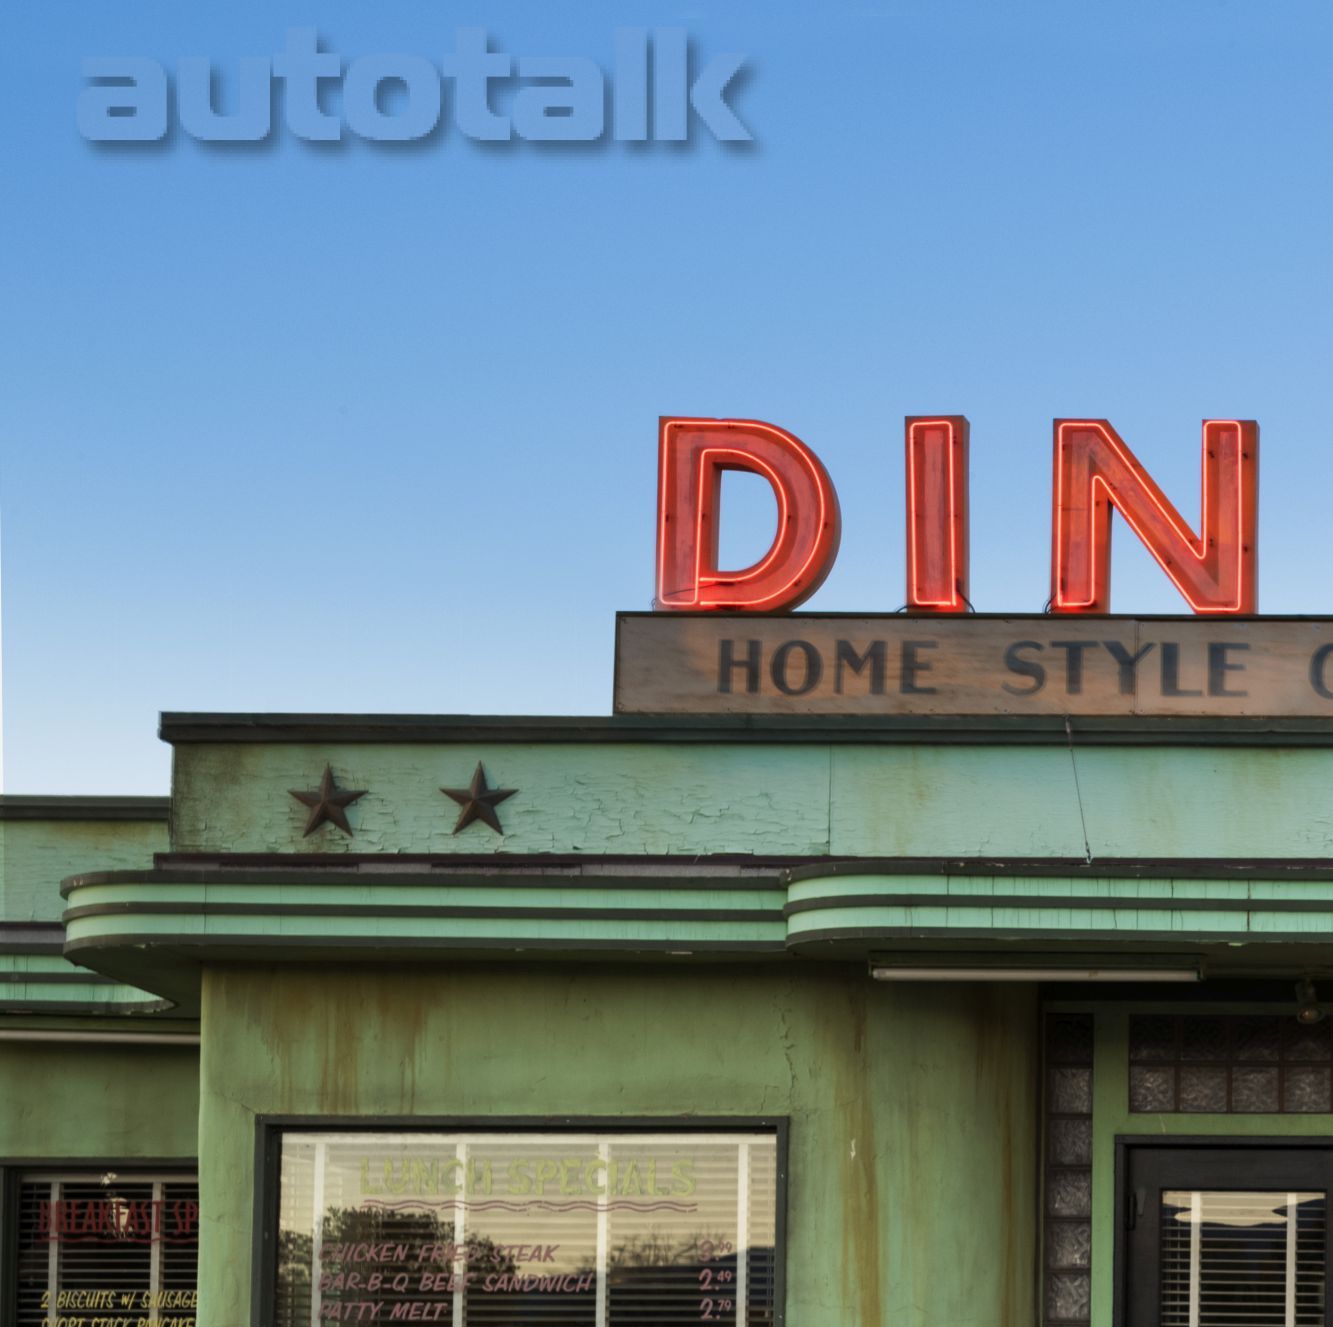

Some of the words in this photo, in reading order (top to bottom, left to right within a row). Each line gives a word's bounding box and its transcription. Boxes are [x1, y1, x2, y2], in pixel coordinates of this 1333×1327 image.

[716, 639, 940, 697] HOME
[1001, 640, 1251, 698] STYLE
[359, 1156, 494, 1196] LUNCH
[506, 1157, 697, 1197] SPECIALS
[38, 1199, 165, 1234] BREAKFAST
[317, 1243, 410, 1263] CHICKEN
[418, 1243, 483, 1263] FRIED
[490, 1243, 561, 1263] STEAK
[317, 1271, 409, 1293] BAR-B-Q
[418, 1272, 477, 1292] BEEF
[482, 1272, 595, 1293] SANDWICH
[698, 1268, 733, 1291] 2.49
[55, 1289, 118, 1309] BISCUITS
[140, 1289, 199, 1309] SAUSAGE
[316, 1301, 385, 1321] PATTY
[389, 1301, 449, 1321] MELT
[699, 1297, 733, 1321] 2.79
